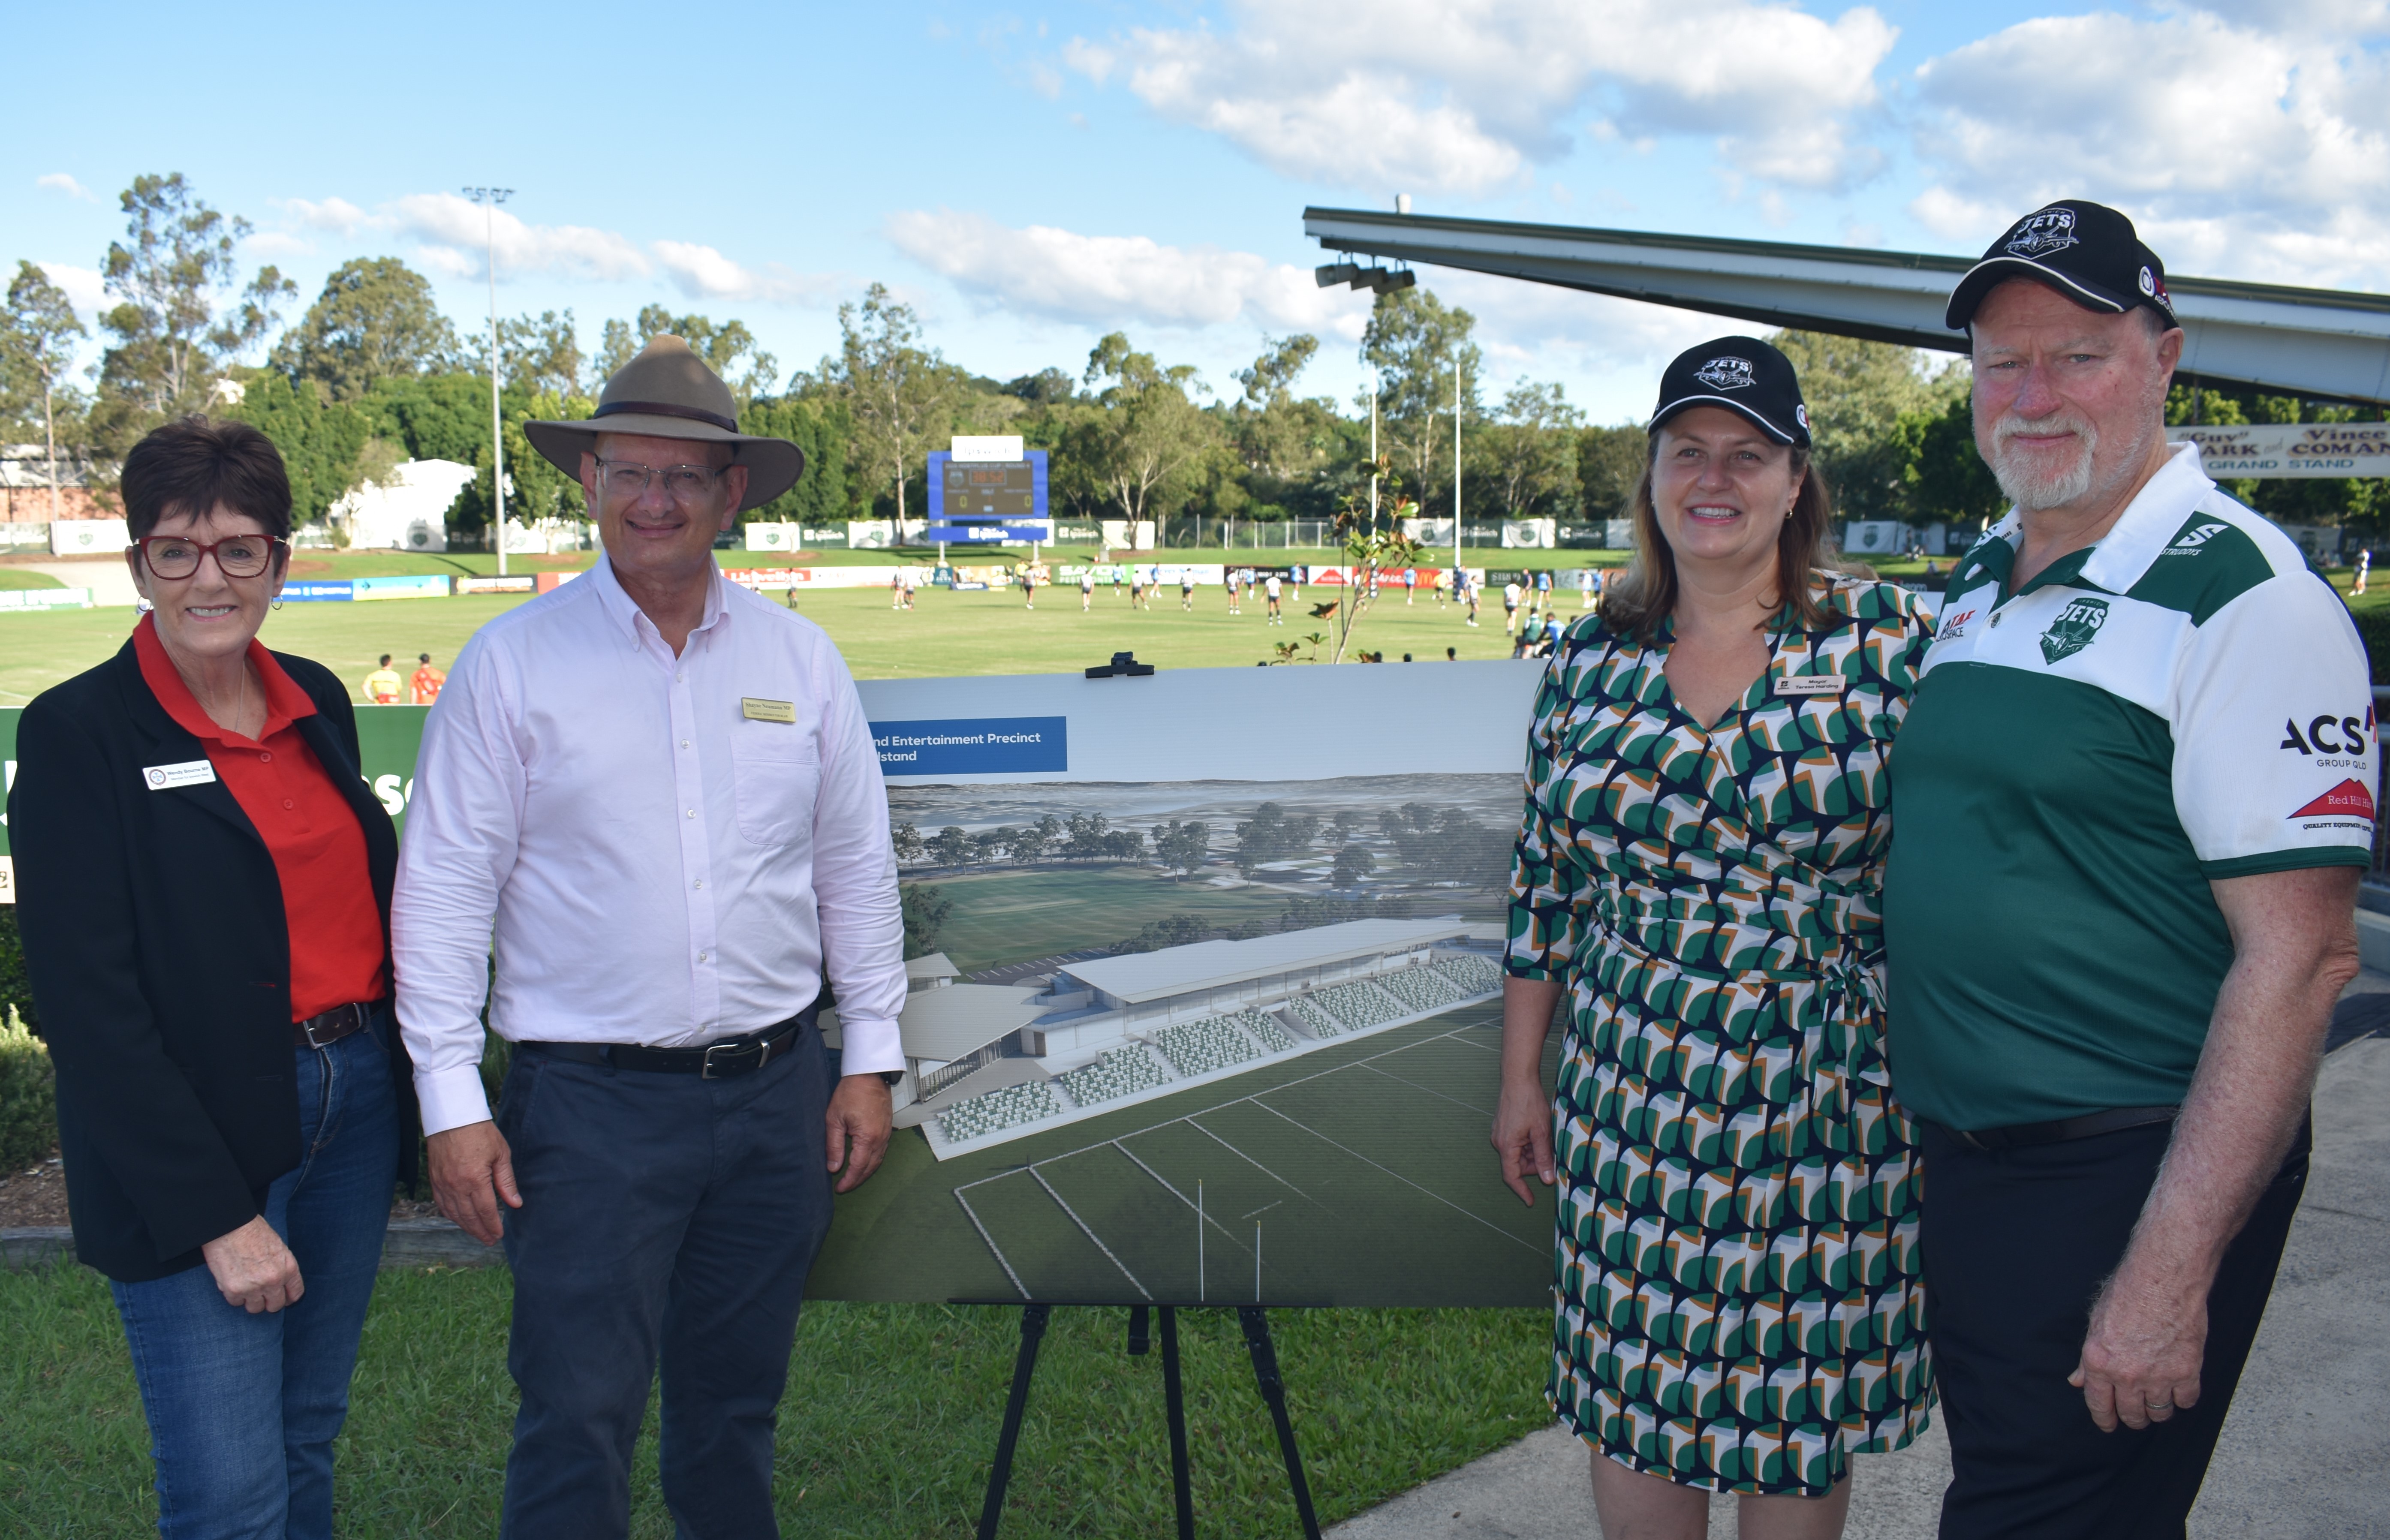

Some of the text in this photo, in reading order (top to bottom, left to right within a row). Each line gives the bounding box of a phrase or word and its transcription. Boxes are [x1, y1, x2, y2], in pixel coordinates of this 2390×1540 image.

[2018, 214, 2071, 234] JETS
[1705, 359, 1749, 372] JETS
[2303, 429, 2387, 442] Vince
[2200, 443, 2261, 457] ARK
[2208, 459, 2354, 469] GRAND STAND
[2160, 547, 2203, 557] STRUDDYS
[2056, 604, 2106, 629] JETS
[873, 732, 1041, 746] nd Entertainment Precinct
[878, 751, 917, 761] stand
[2317, 759, 2366, 770] GROUP QLD
[2327, 795, 2348, 805] Red
[2350, 796, 2362, 806] Hill
